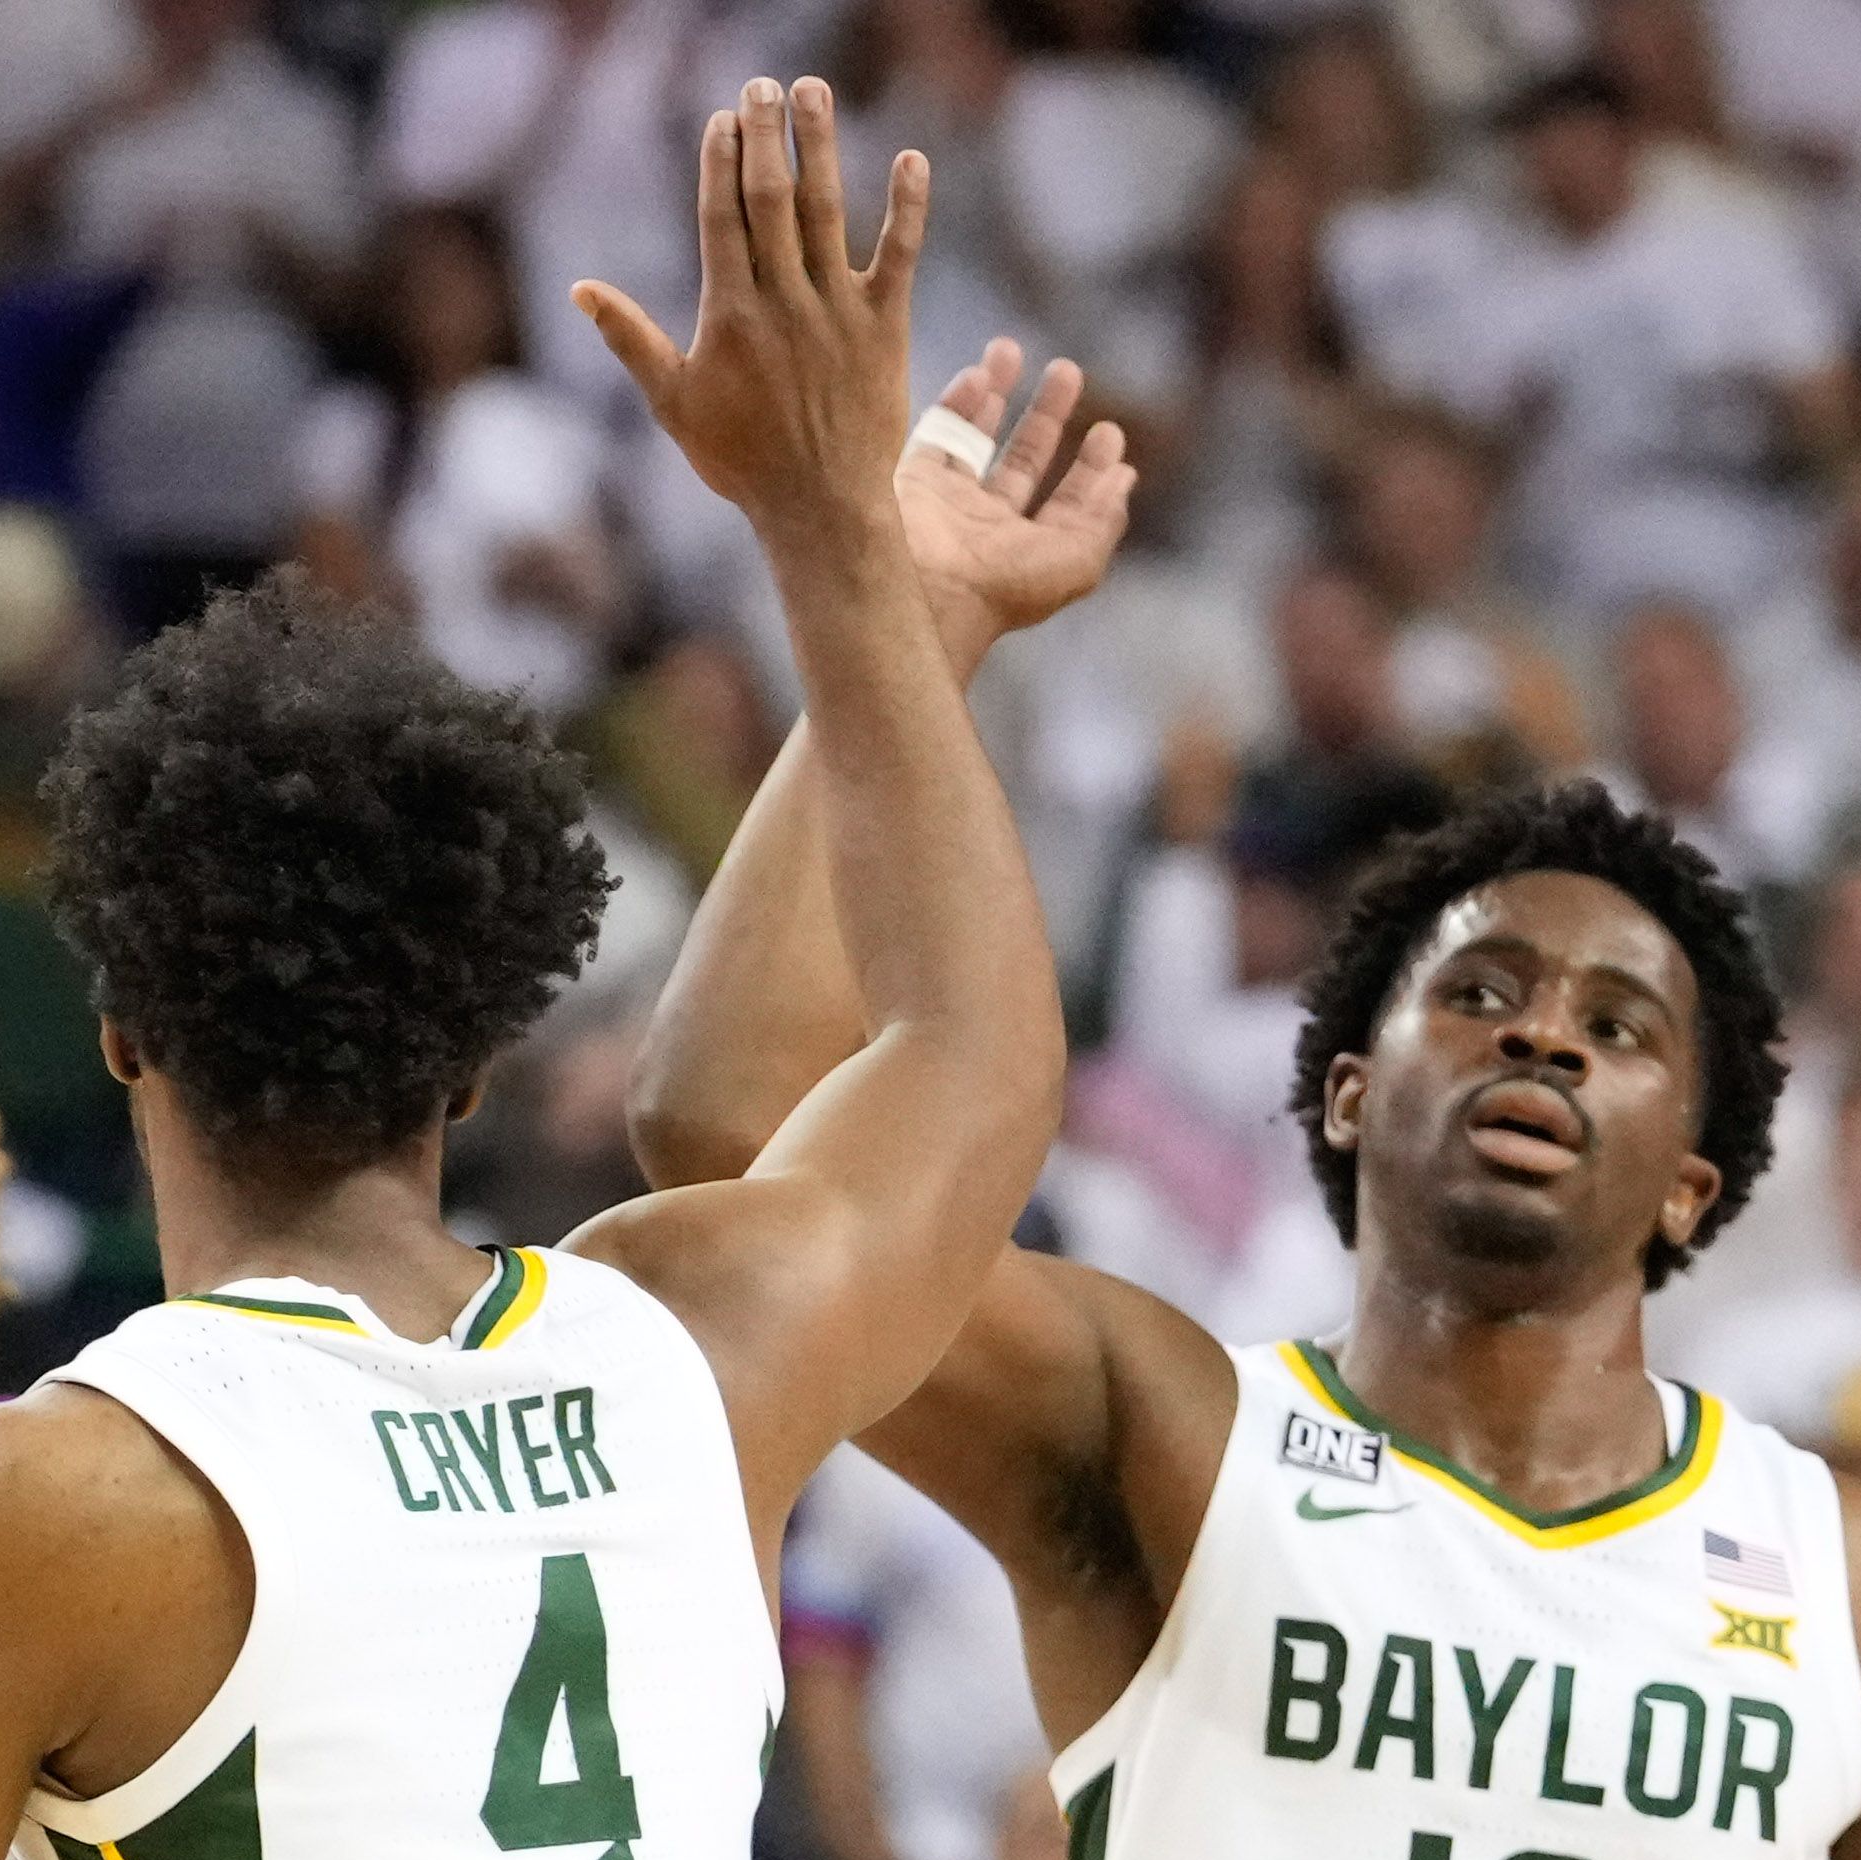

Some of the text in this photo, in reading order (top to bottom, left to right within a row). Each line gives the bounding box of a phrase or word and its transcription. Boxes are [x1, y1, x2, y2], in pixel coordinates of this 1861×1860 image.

[371, 1386, 617, 1513] CRYER
[1283, 1412, 1382, 1483] ONE
[1263, 1616, 1795, 1843] BAYLOR
